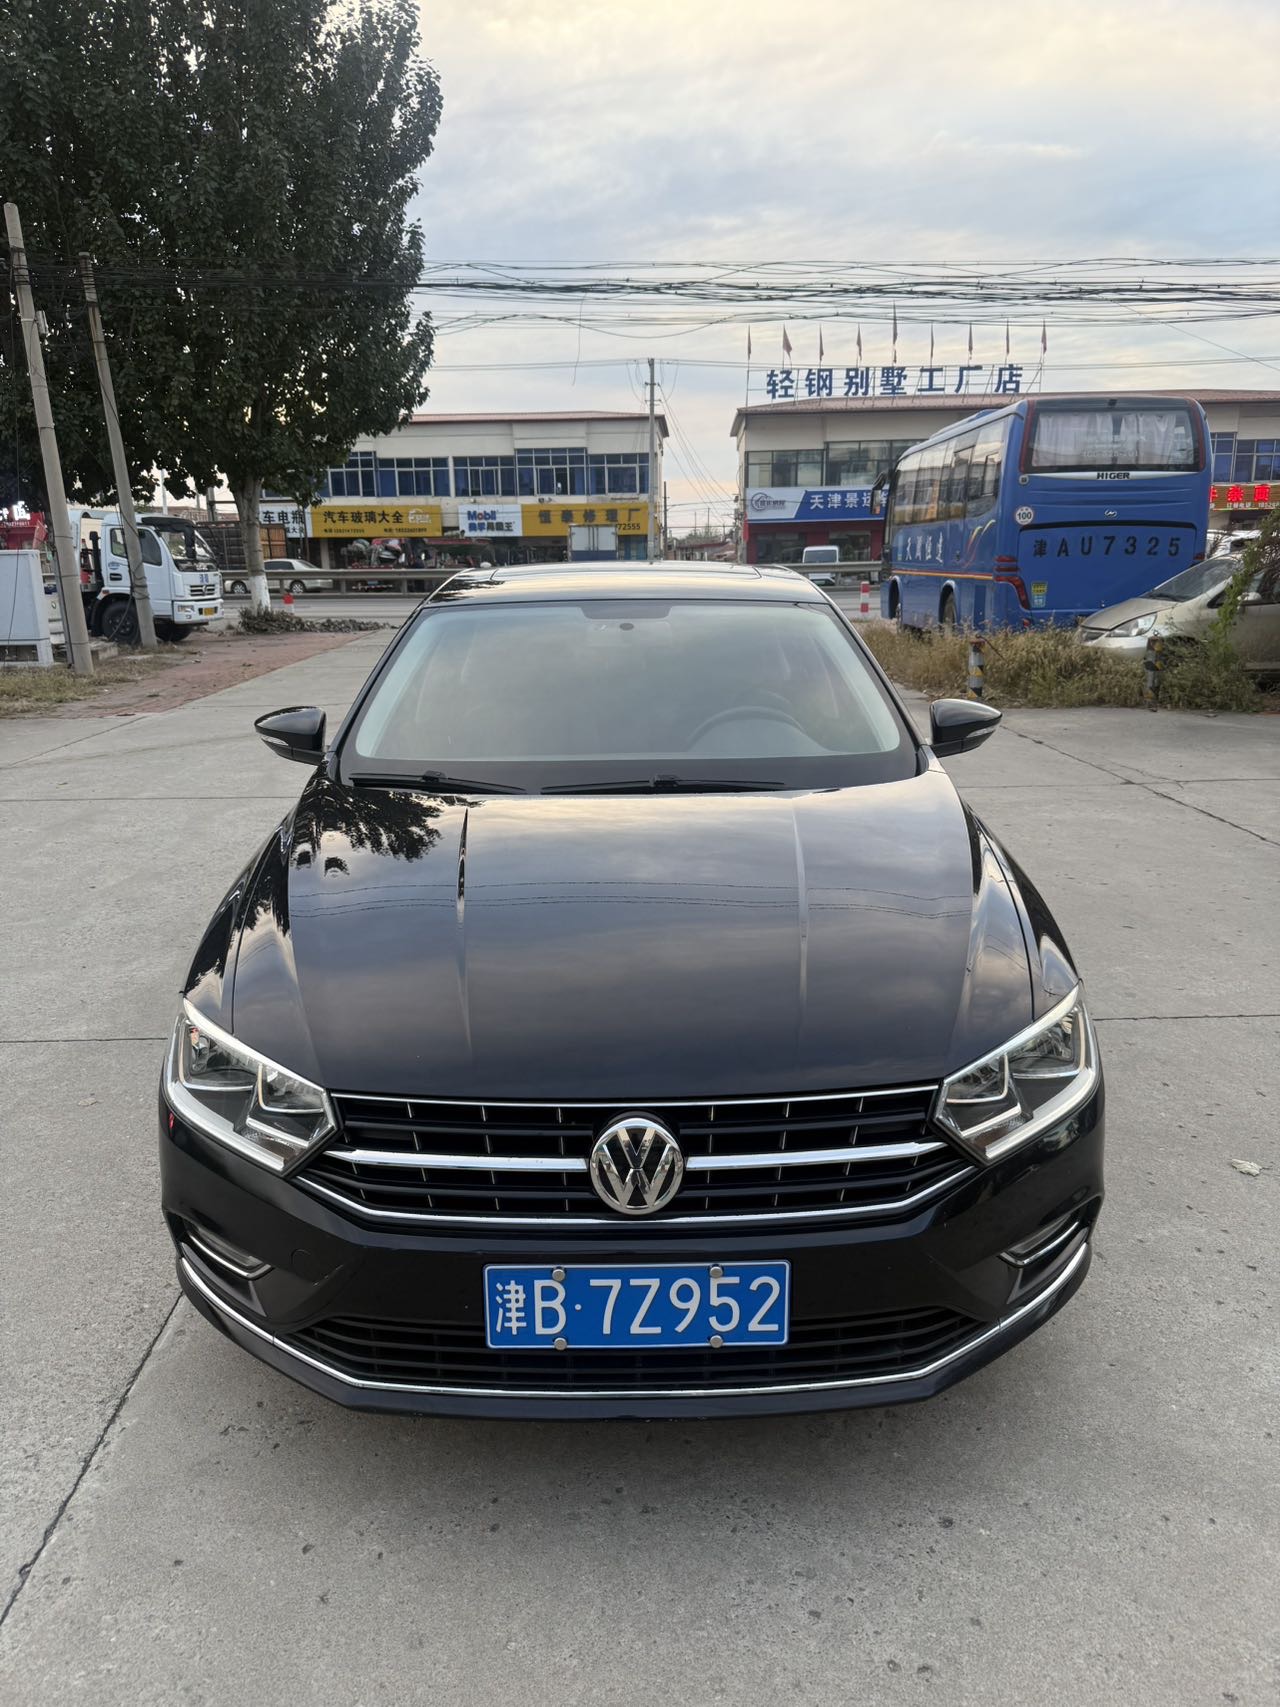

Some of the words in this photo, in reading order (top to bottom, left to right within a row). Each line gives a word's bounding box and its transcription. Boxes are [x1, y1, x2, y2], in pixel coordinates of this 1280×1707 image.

[766, 364, 1023, 399] 轻钢别墅工厂店
[323, 510, 404, 524] 汽车玻璃大全
[467, 510, 497, 521] Mobil
[1017, 512, 1032, 520] 100
[1033, 536, 1181, 558] 津AU7325
[495, 1275, 781, 1335] 津B·7Z952
